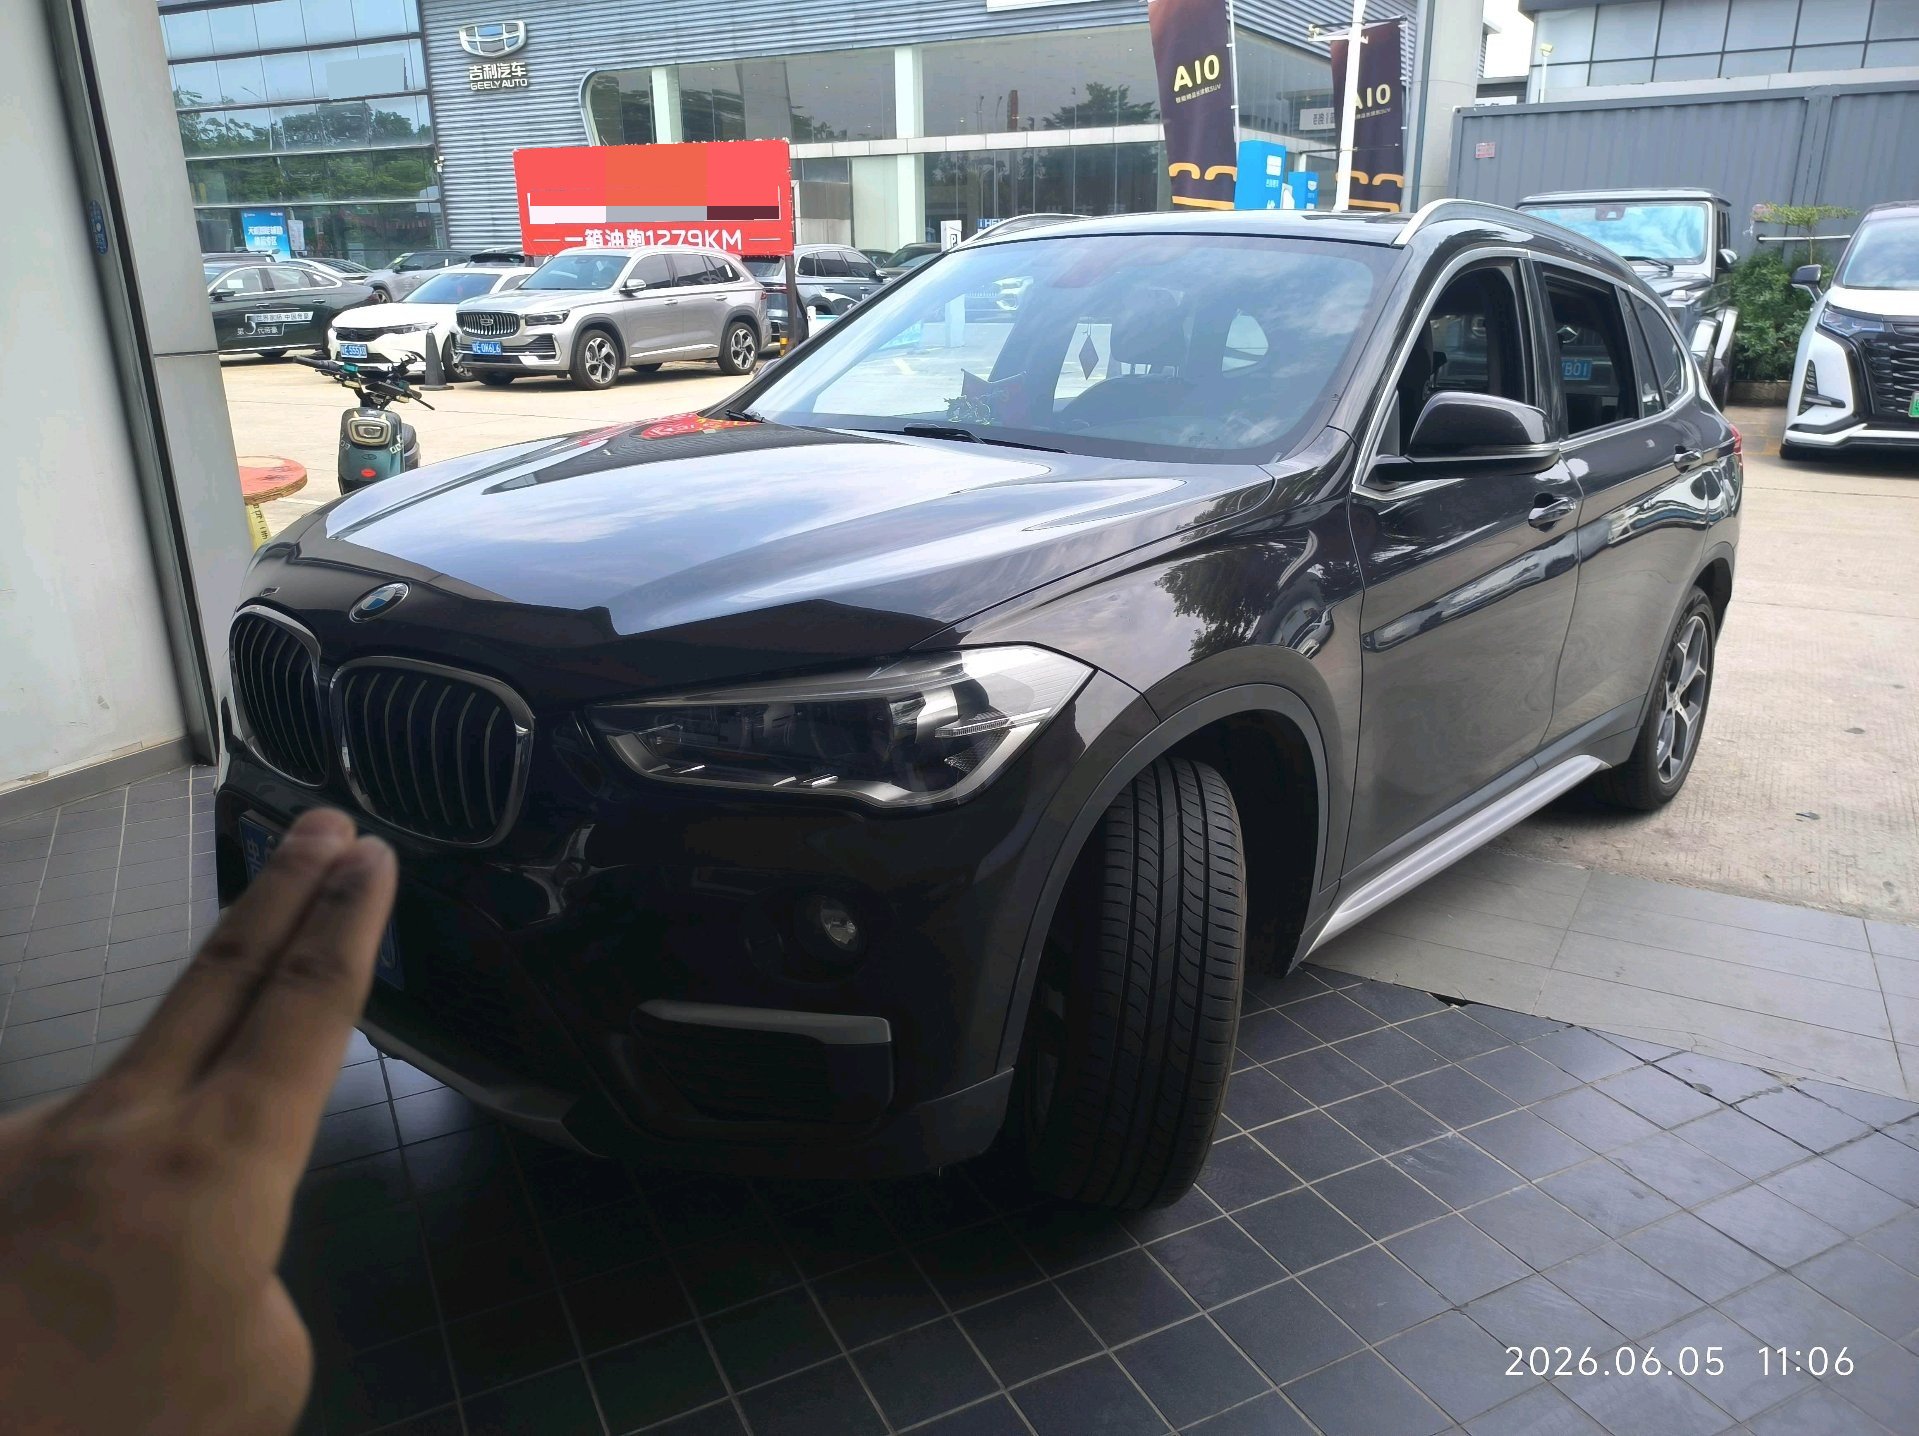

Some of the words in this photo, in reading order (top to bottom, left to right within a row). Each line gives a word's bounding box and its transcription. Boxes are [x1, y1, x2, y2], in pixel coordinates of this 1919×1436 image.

[469, 62, 526, 80] 吉利汽车
[470, 80, 500, 90] GEELY
[502, 78, 528, 88] AUTO
